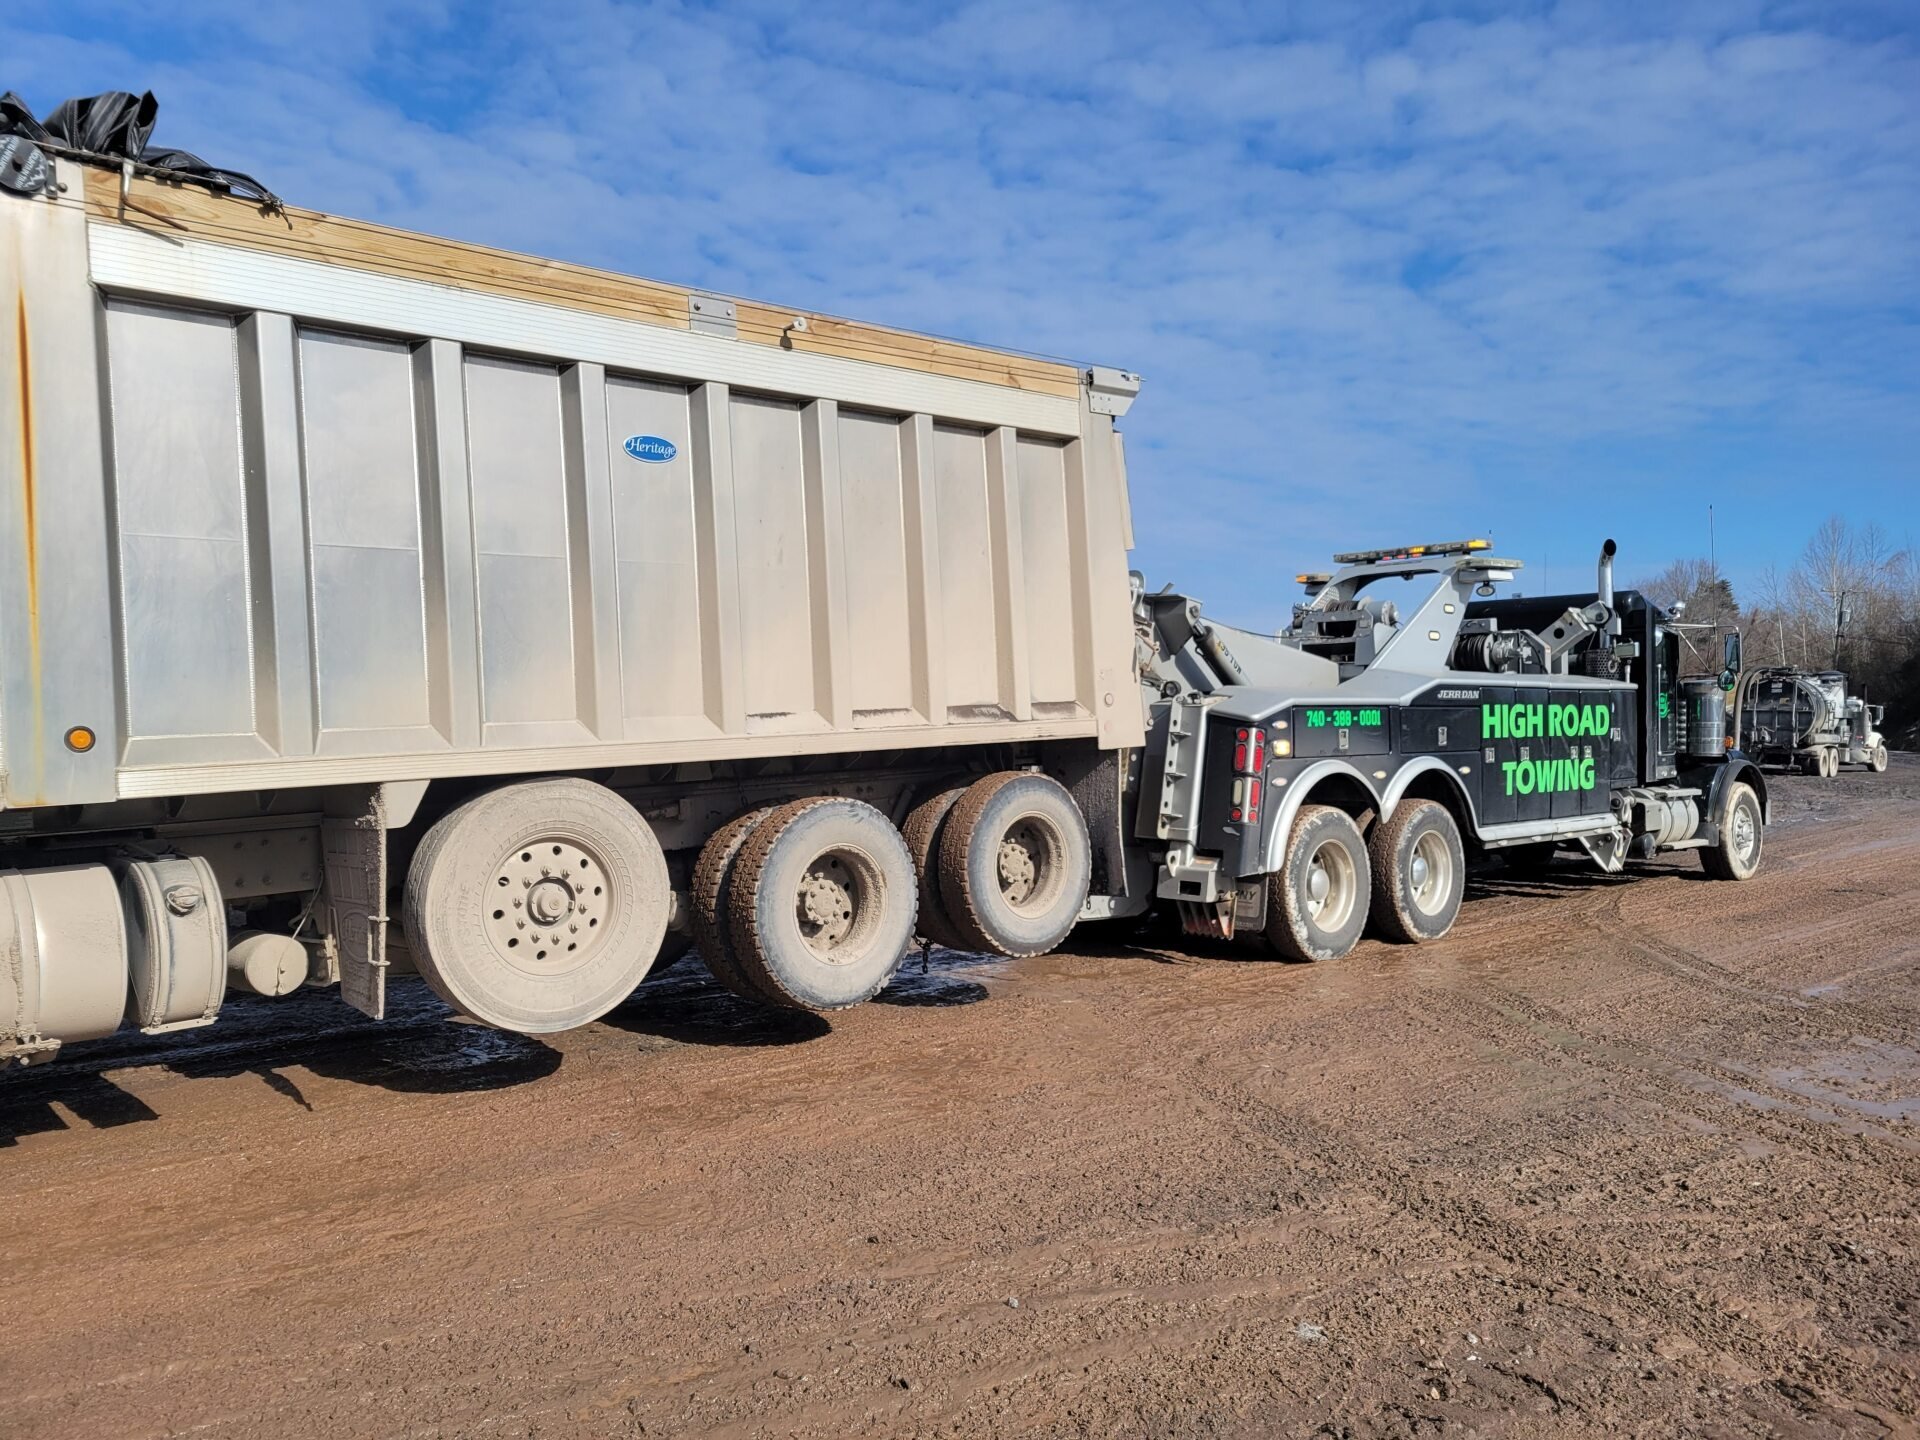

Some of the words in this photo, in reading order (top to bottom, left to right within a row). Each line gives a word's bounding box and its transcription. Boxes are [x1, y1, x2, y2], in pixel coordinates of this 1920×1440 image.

[626, 437, 676, 459] Heritage
[1482, 704, 1543, 738] HIGH
[1548, 704, 1610, 737] ROAD
[1502, 758, 1595, 796] TOWING
